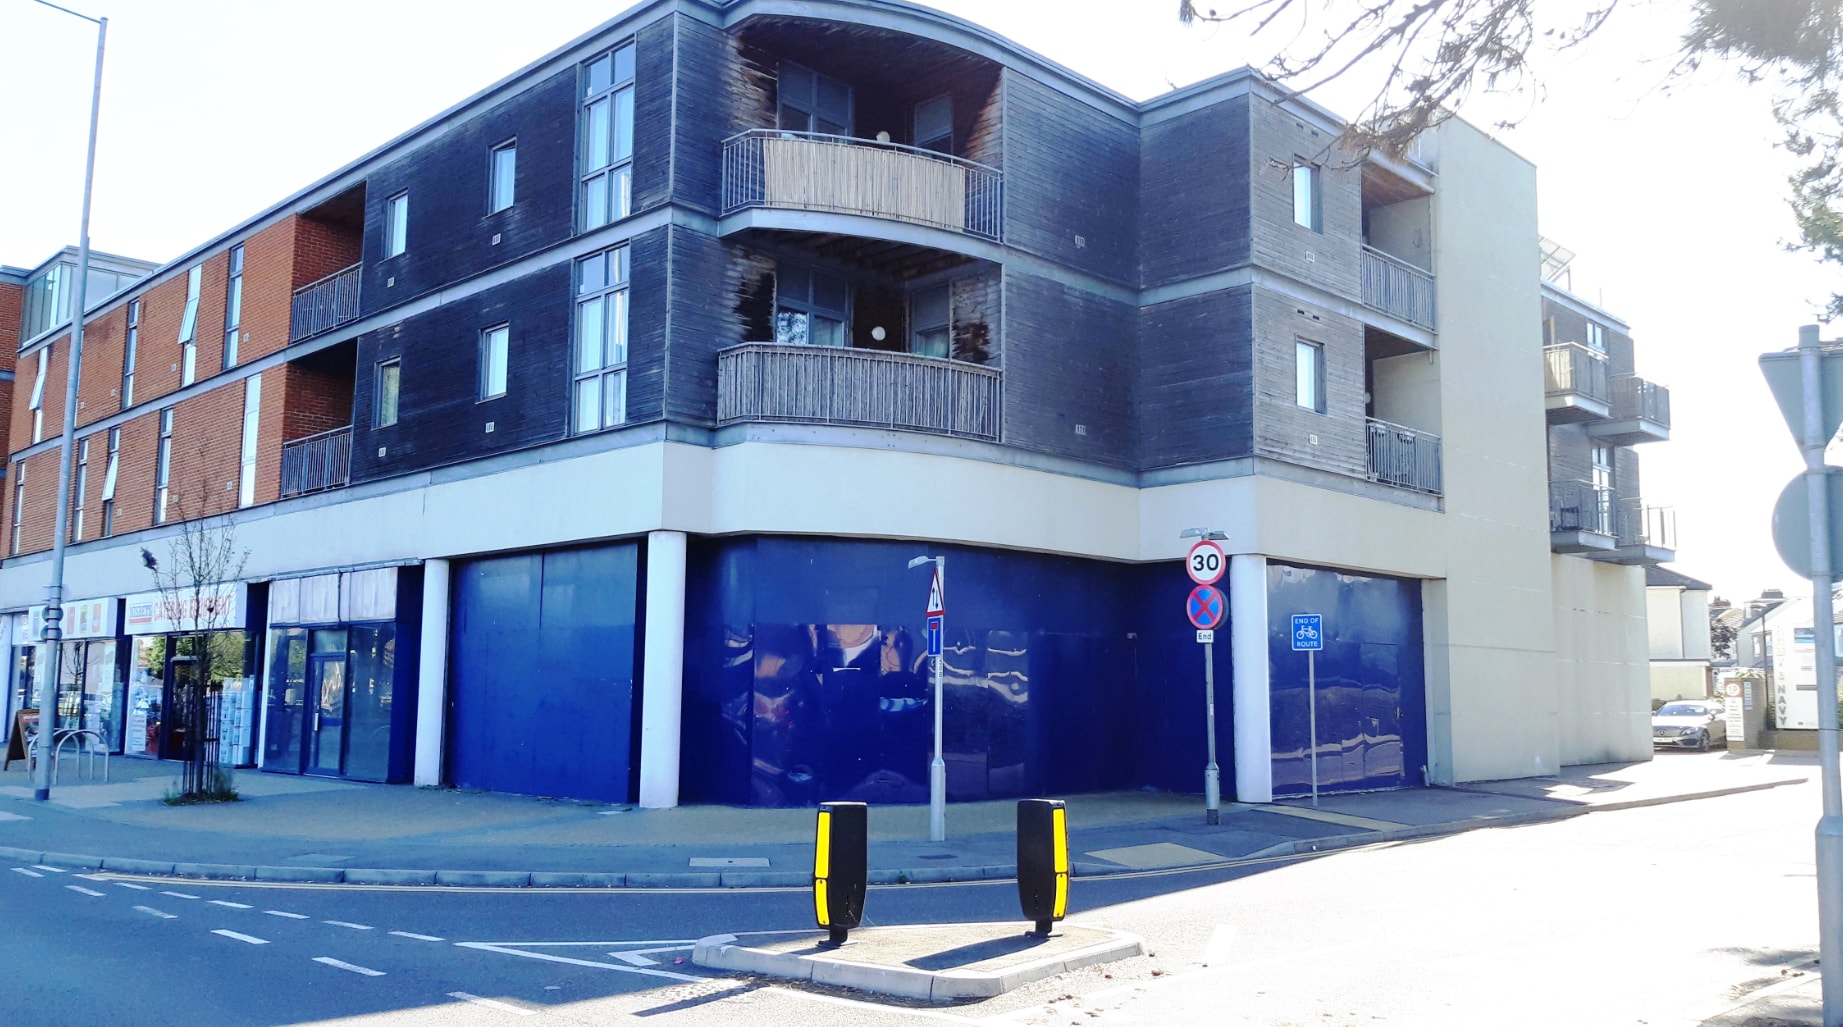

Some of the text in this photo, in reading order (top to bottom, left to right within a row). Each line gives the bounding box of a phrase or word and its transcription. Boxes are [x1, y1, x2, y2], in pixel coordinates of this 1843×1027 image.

[1193, 554, 1219, 571] 30
[154, 601, 186, 620] CATERING
[1198, 632, 1212, 641] End
